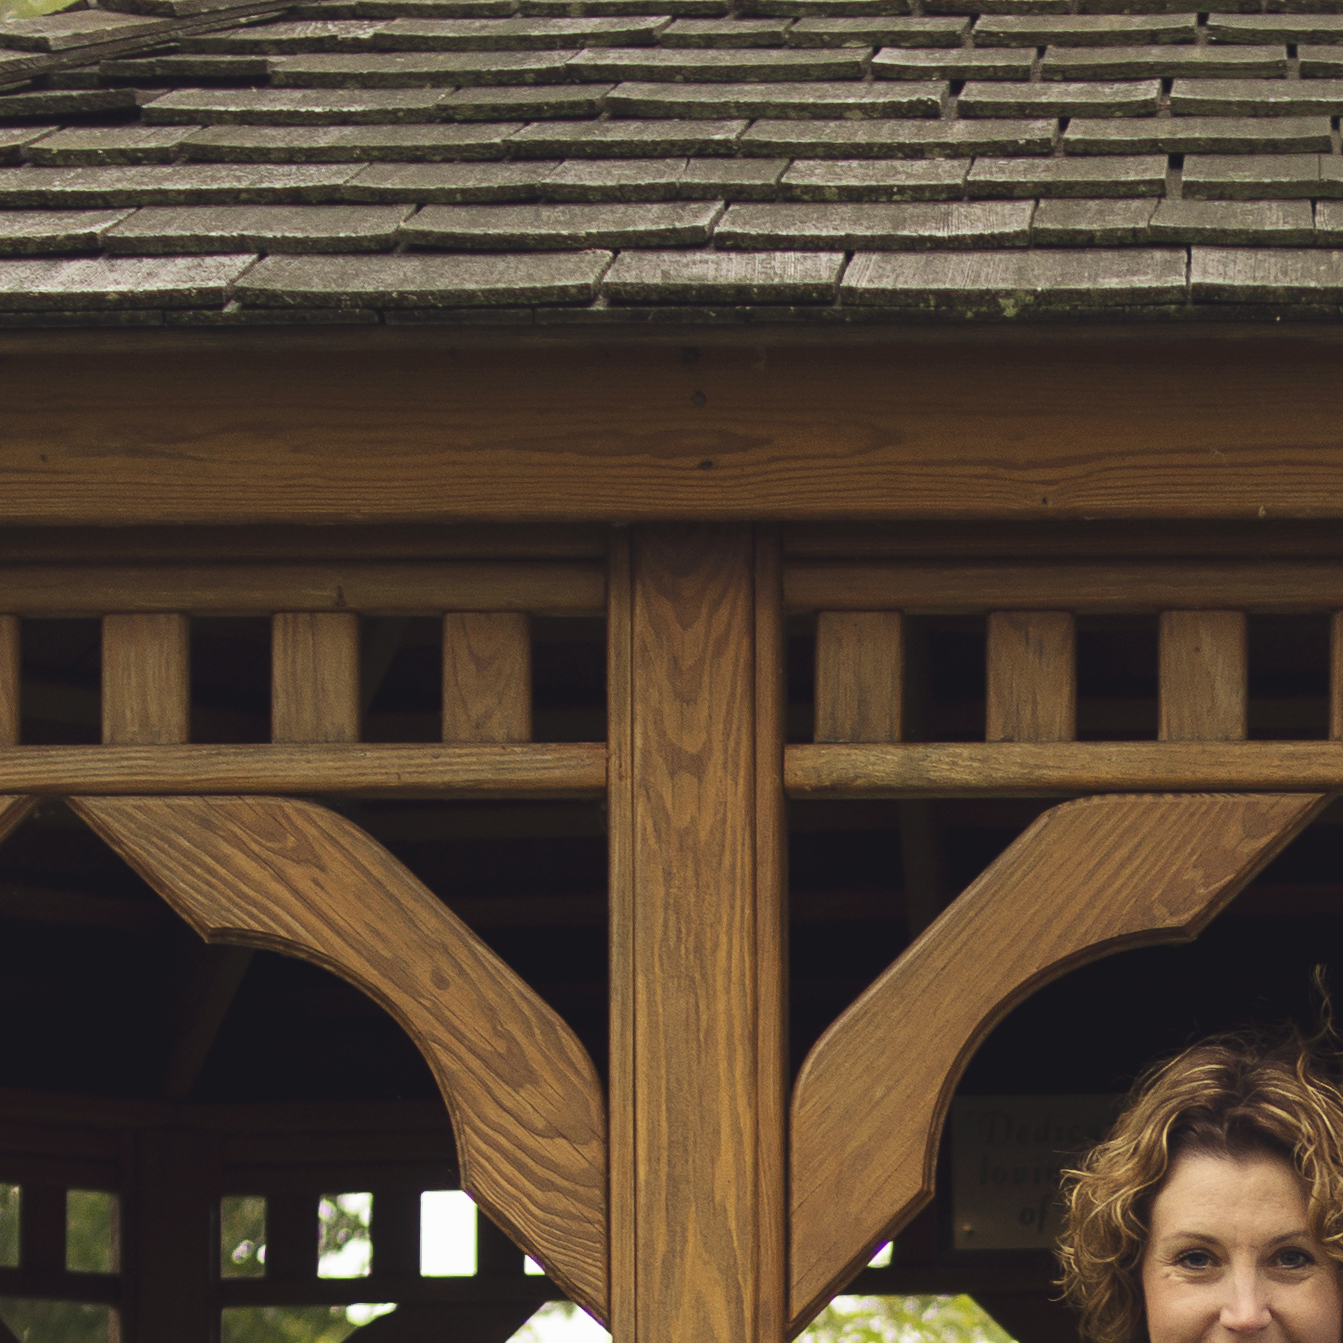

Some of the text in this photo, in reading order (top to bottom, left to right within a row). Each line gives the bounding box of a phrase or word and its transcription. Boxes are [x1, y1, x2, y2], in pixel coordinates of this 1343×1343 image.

[979, 1108, 1103, 1144] Dedica
[978, 1153, 1060, 1186] lovin
[1018, 1192, 1052, 1235] of
